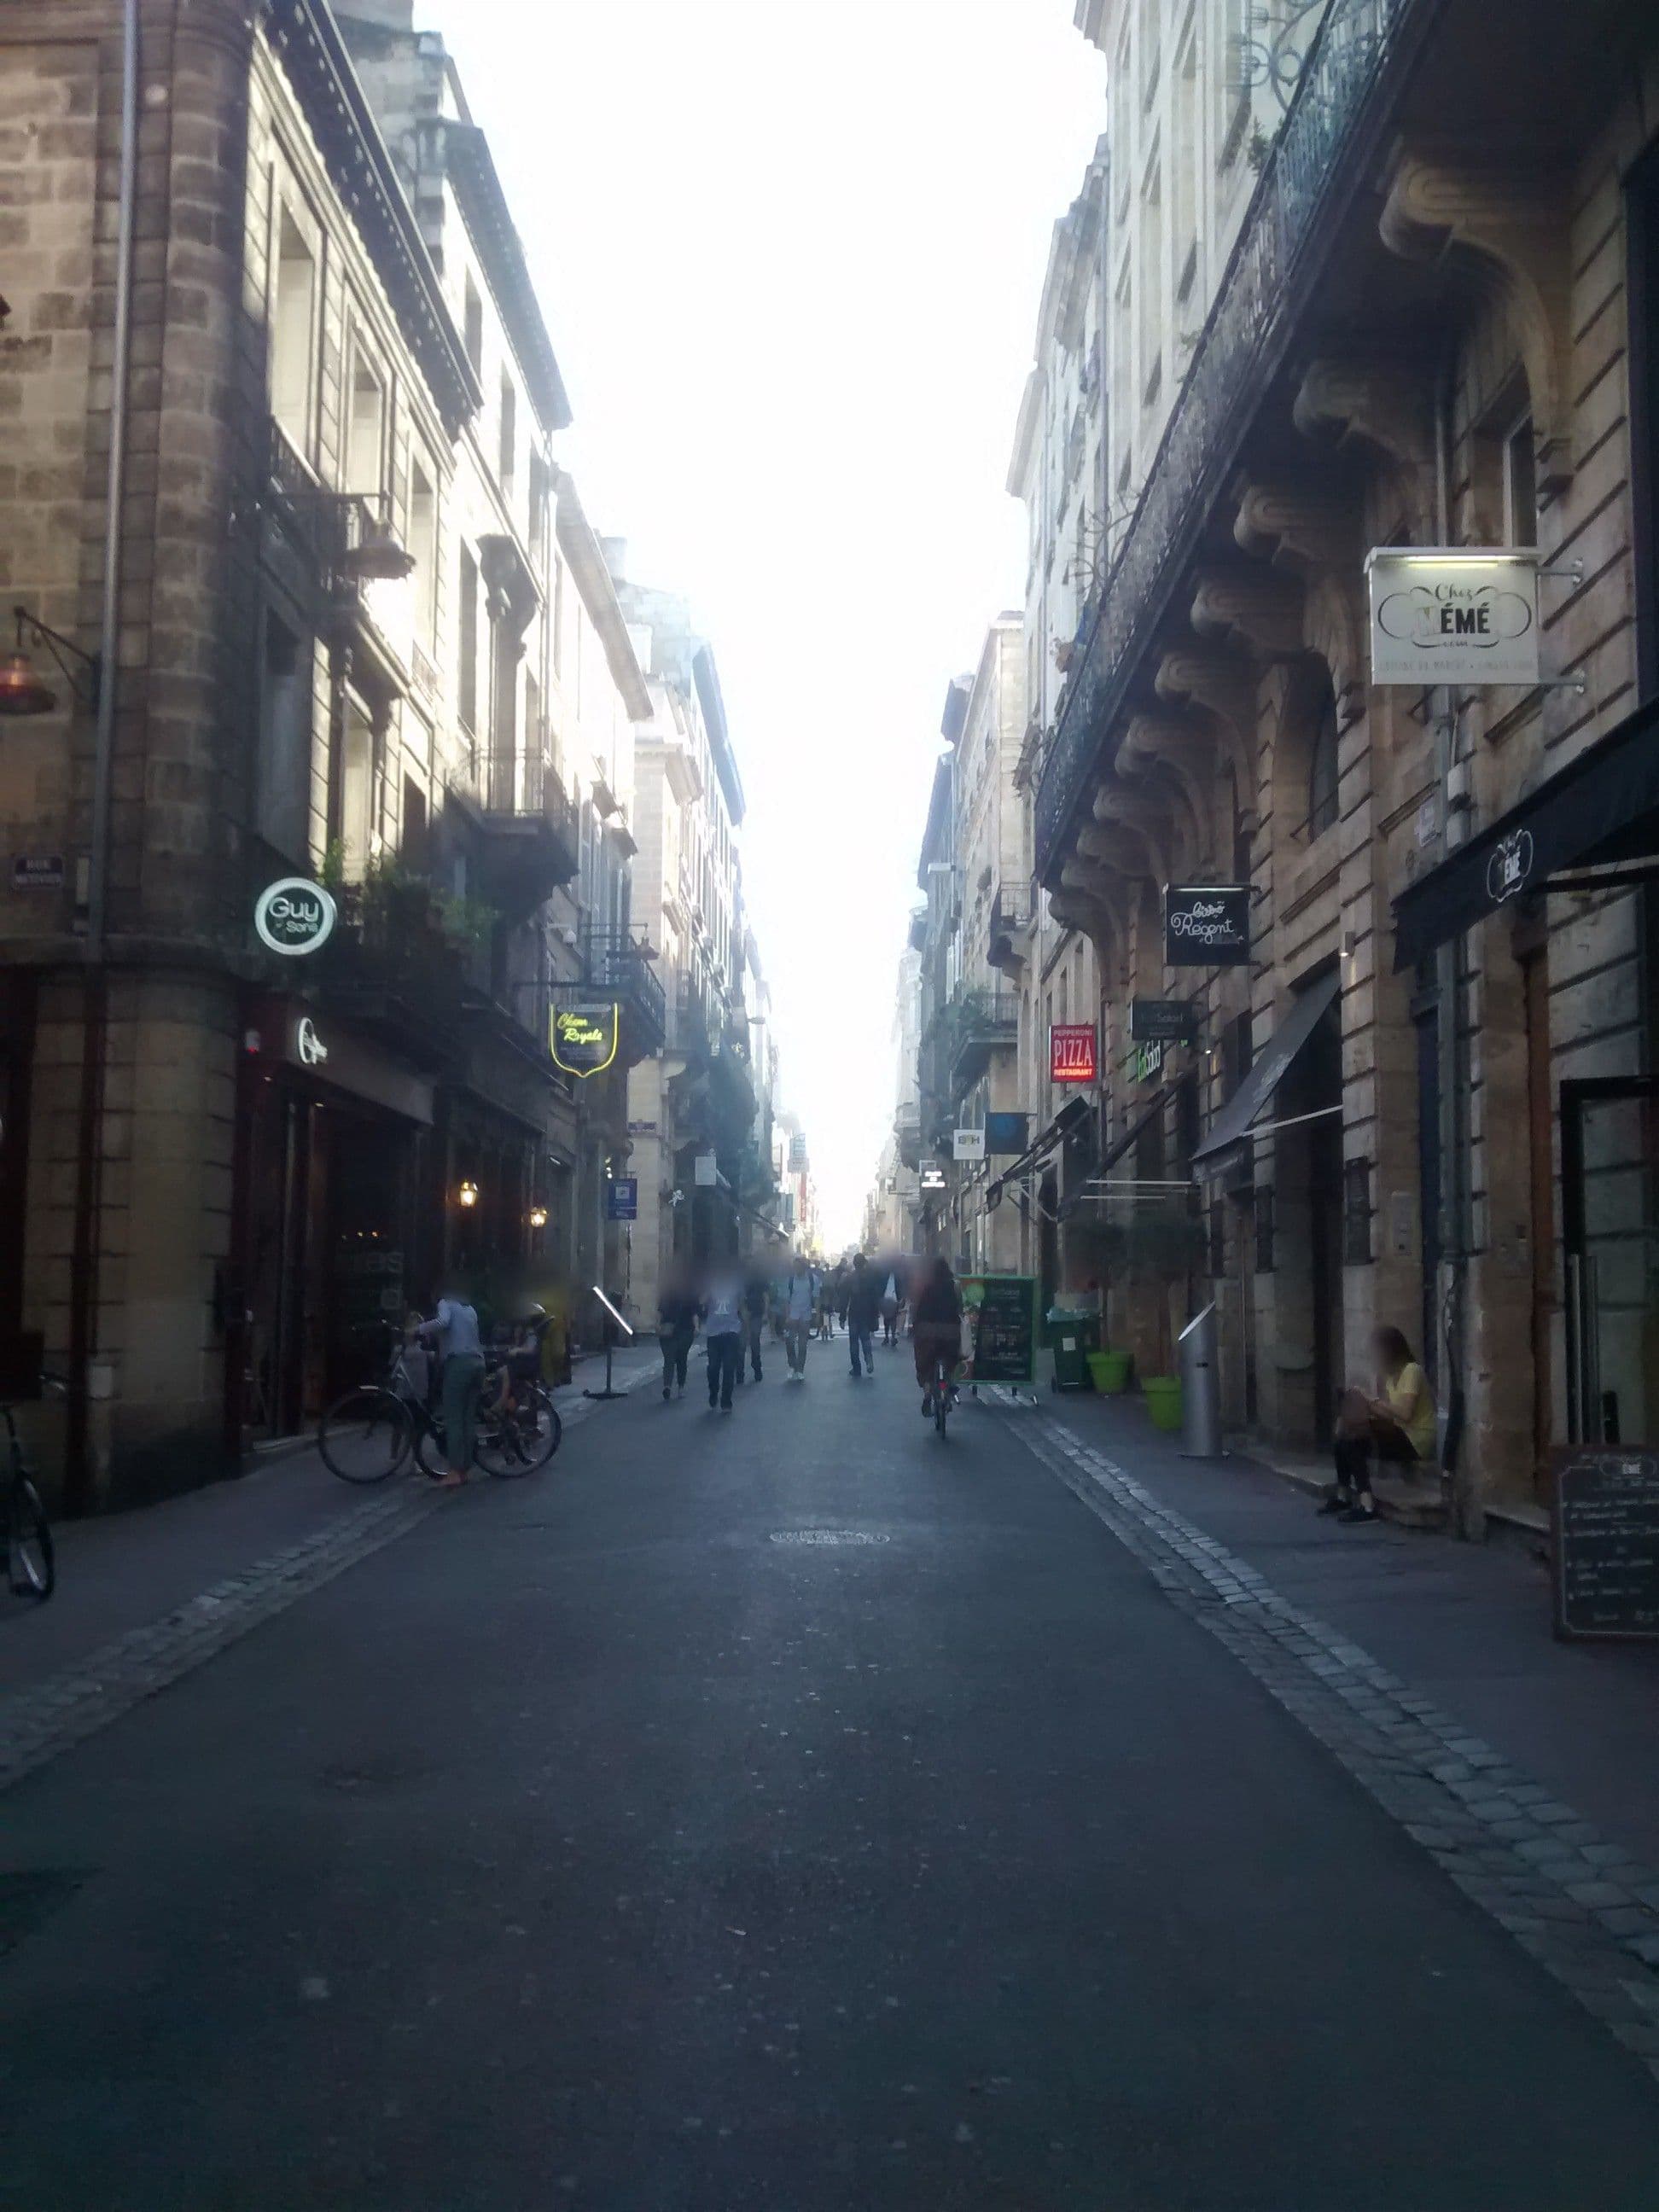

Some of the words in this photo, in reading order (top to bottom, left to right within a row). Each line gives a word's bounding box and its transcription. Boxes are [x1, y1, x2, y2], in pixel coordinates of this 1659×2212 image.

[1435, 583, 1474, 602] Chez
[268, 896, 319, 923] Guy
[563, 1027, 603, 1045] Royale
[1053, 1028, 1093, 1038] PEPPERONI
[1053, 1039, 1093, 1067] PIZZA
